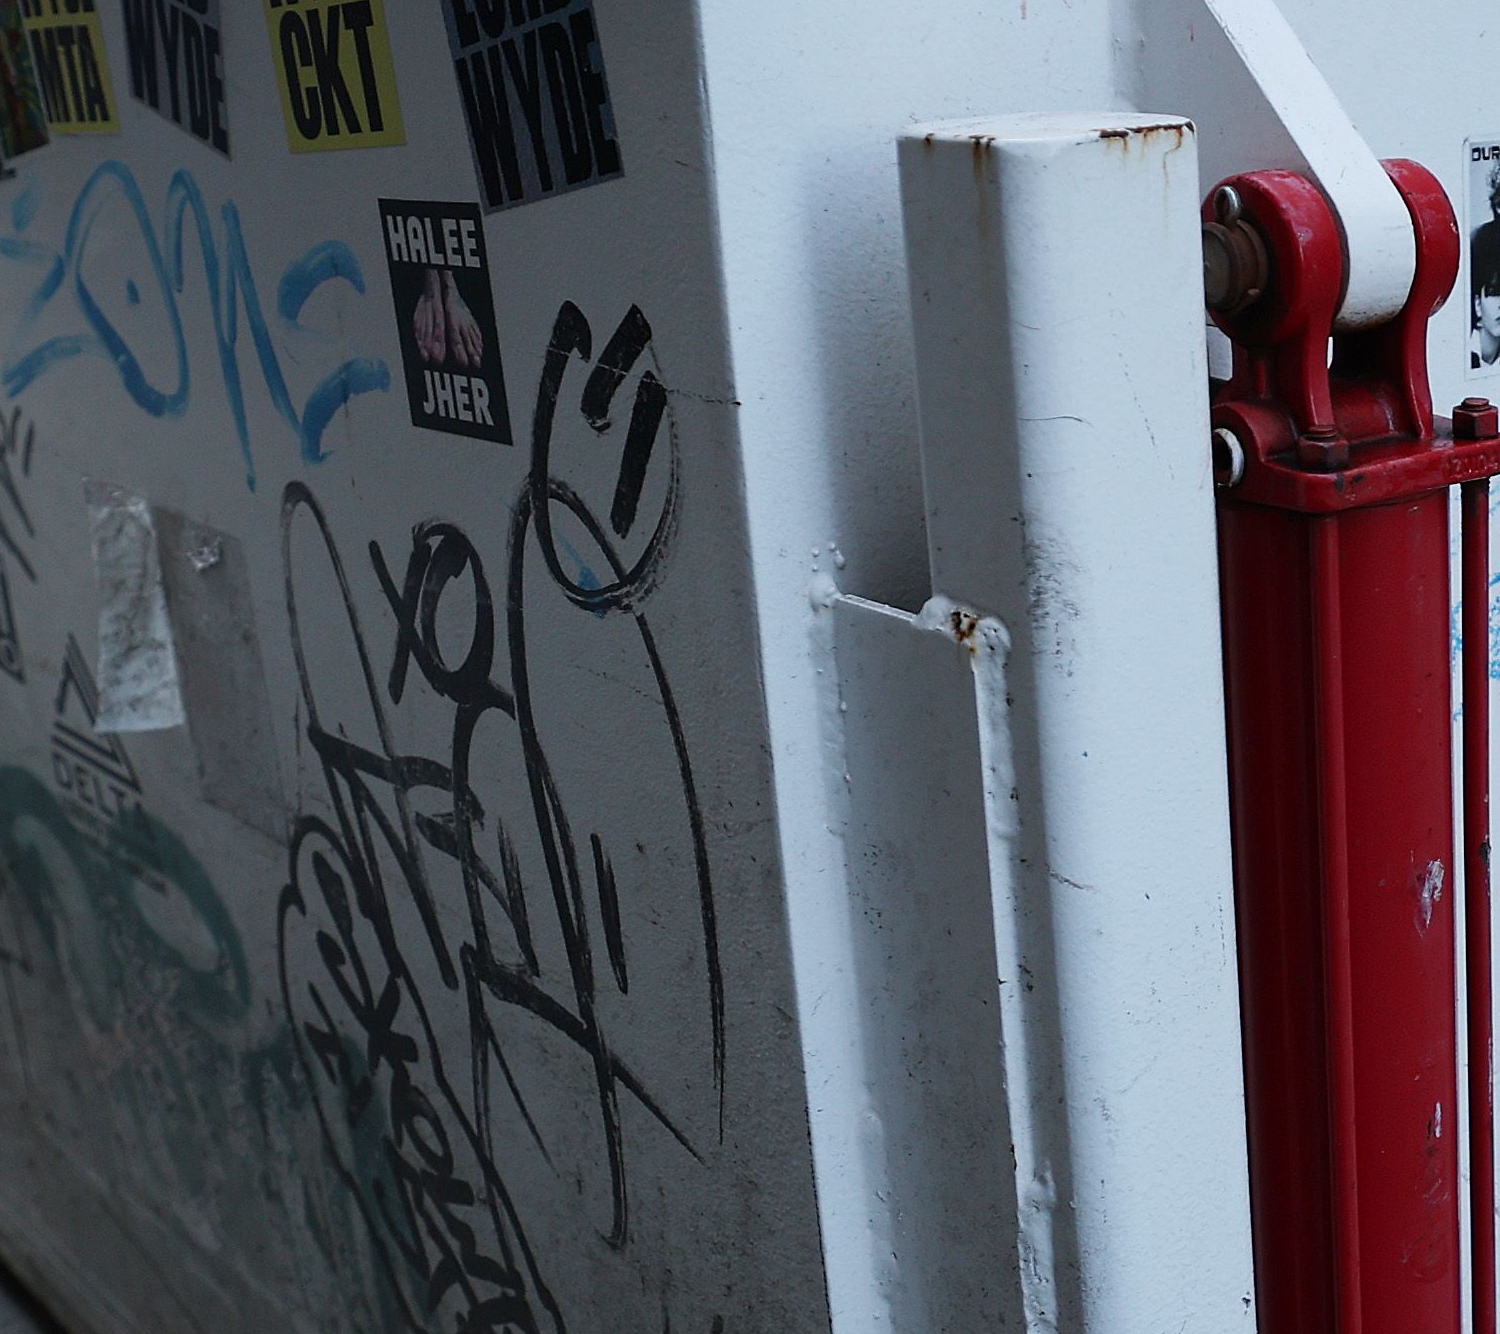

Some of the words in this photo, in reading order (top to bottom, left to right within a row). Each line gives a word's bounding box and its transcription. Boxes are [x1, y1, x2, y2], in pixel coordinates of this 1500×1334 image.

[29, 23, 110, 123] MTA
[279, 0, 384, 140] CKT
[455, 8, 622, 207] WYDE
[386, 214, 481, 268] HALEE
[423, 369, 494, 427] JHER
